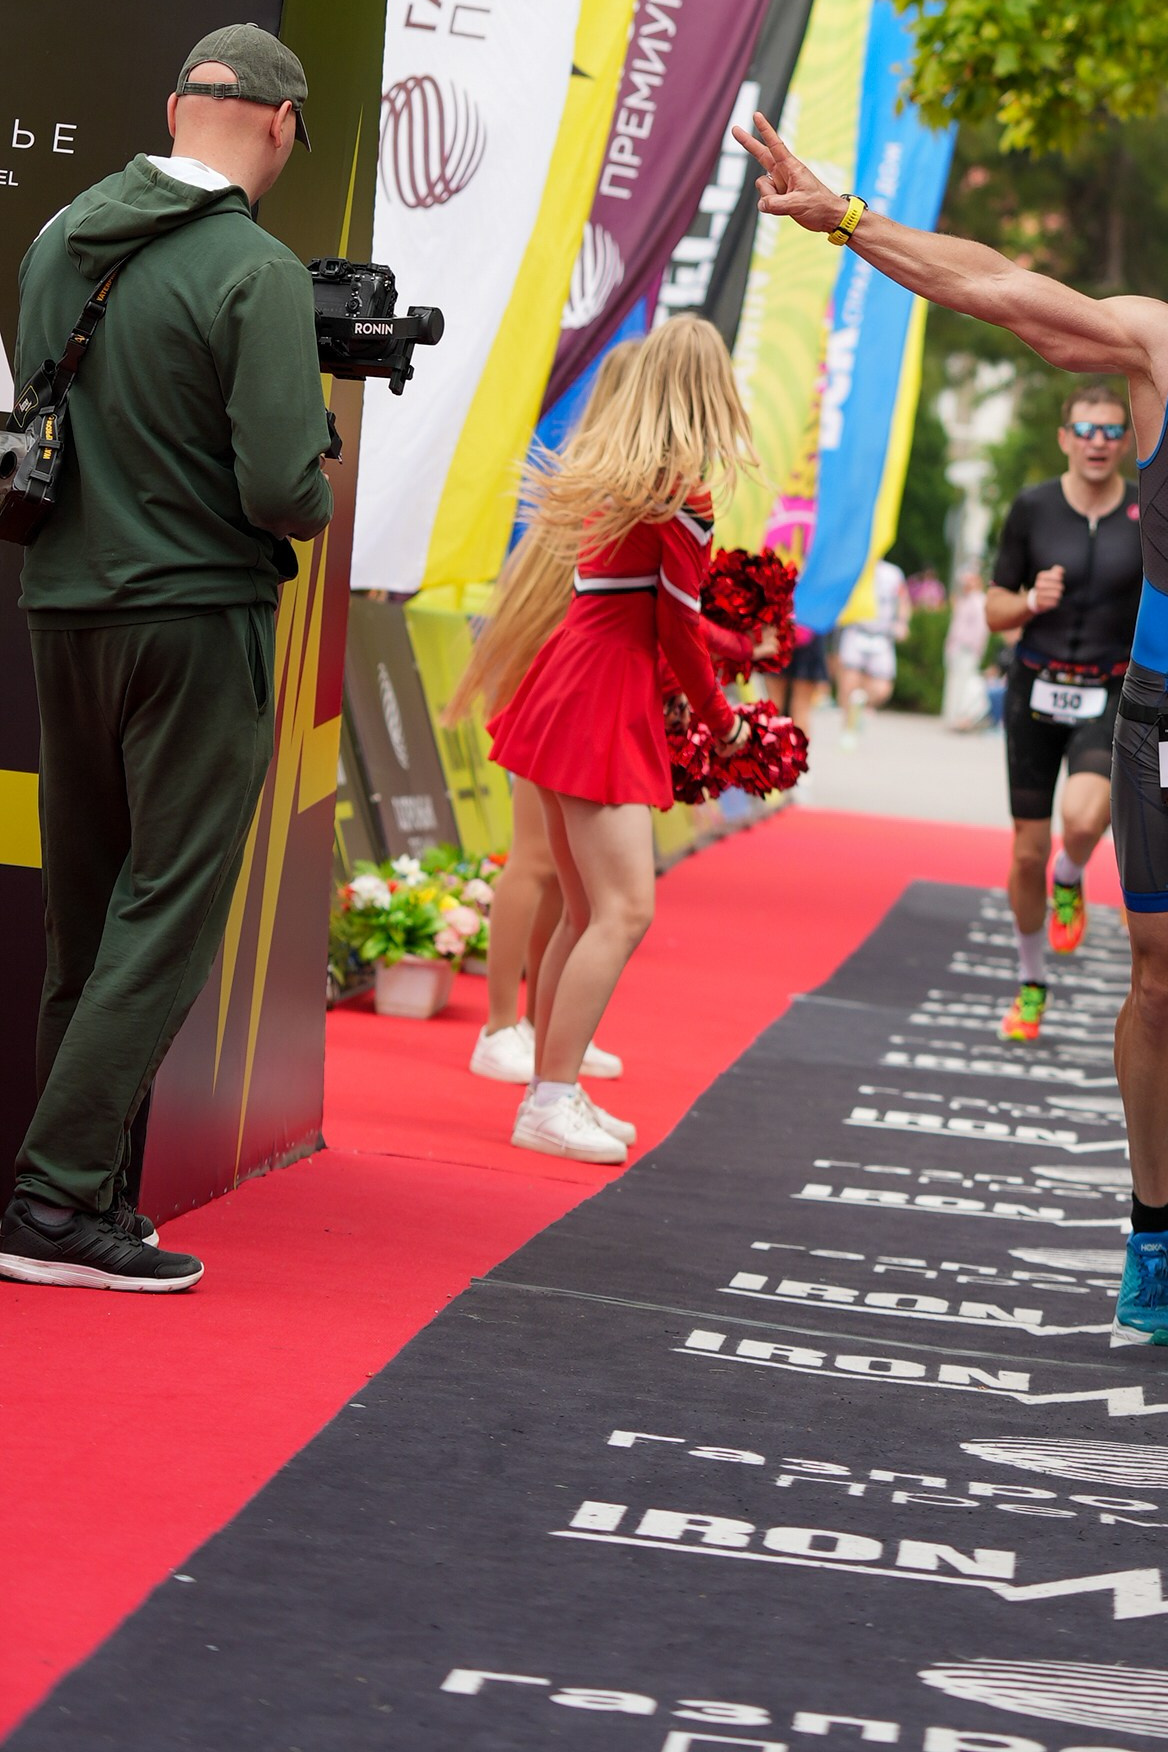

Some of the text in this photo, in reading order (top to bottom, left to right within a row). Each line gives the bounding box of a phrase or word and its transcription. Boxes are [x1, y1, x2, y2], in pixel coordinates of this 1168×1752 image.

[354, 322, 394, 335] RONIN
[1050, 691, 1082, 710] 150
[801, 1183, 1066, 1221] IRON
[728, 1271, 1044, 1326] IRON
[684, 1329, 1031, 1392] IRON
[568, 1500, 1016, 1579] IRON
[440, 1668, 1140, 1752] Газпр
